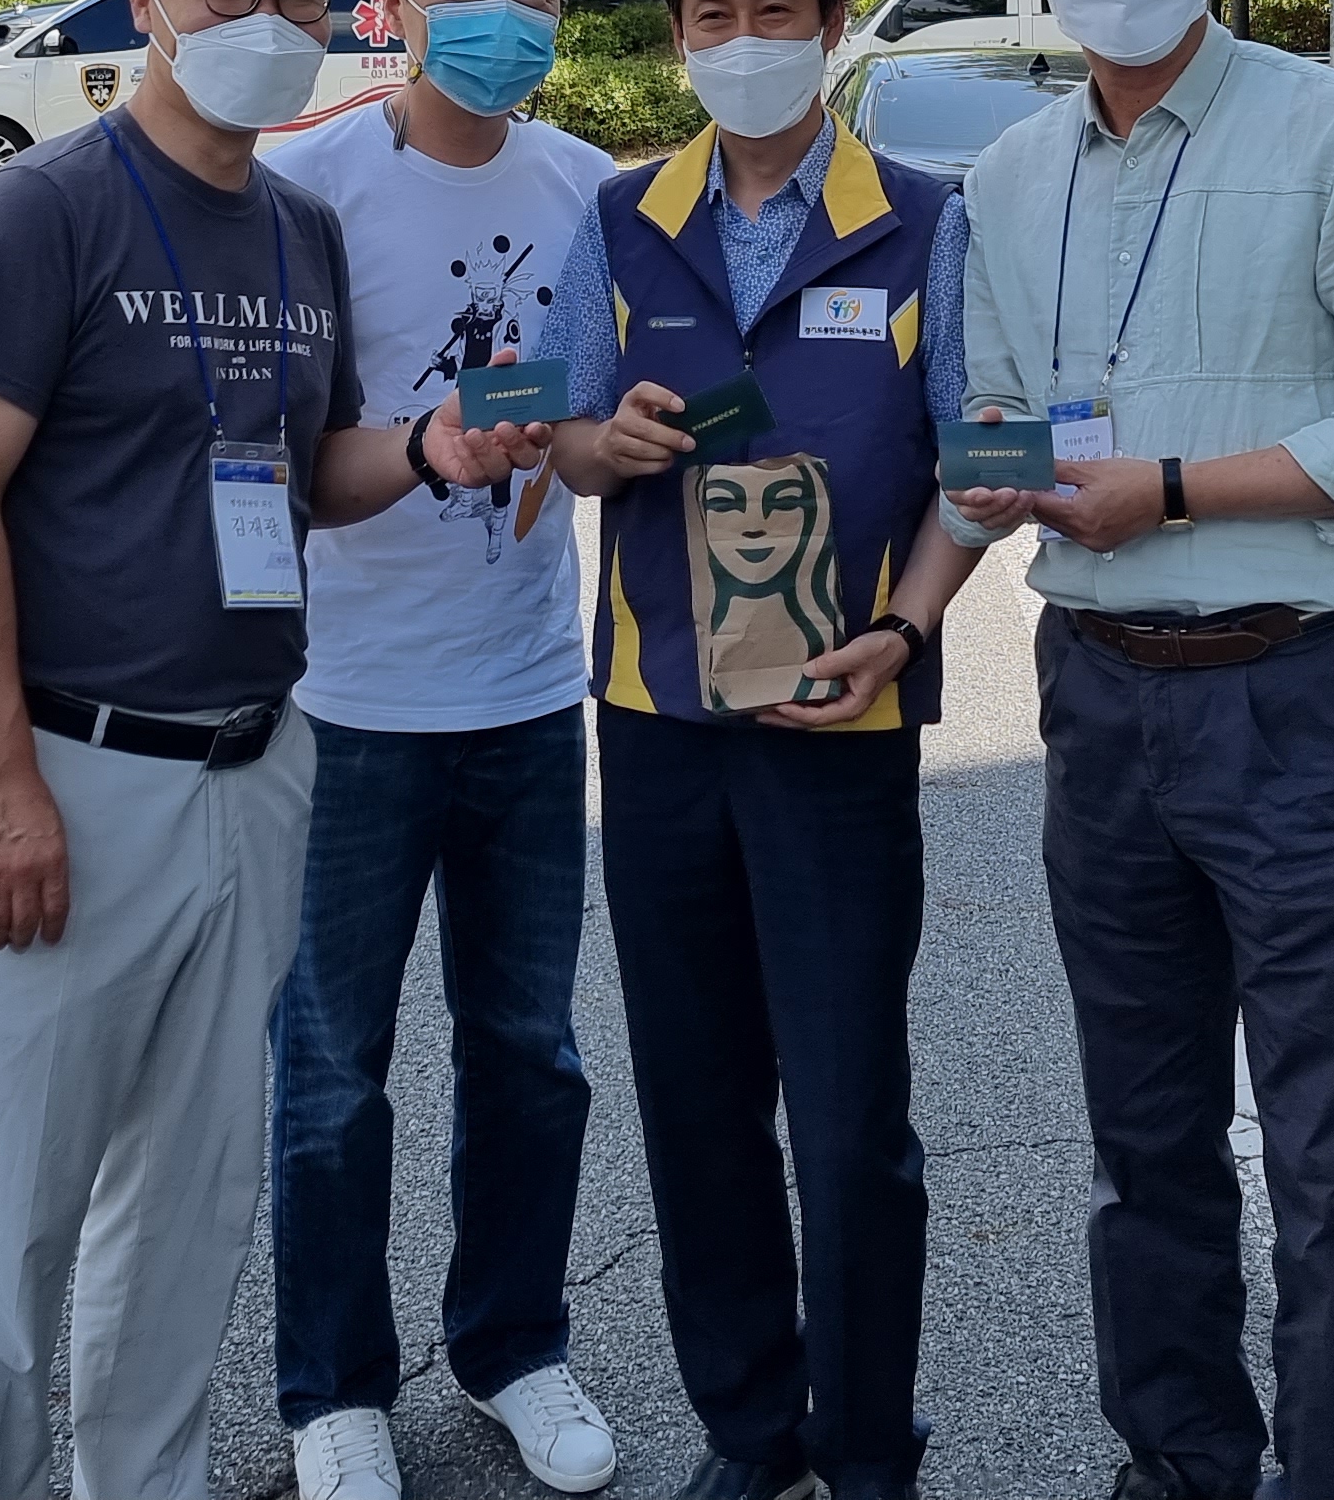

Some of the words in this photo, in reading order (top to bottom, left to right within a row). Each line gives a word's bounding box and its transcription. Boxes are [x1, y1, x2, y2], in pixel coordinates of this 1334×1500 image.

[113, 290, 336, 342] WELLMADE
[170, 335, 191, 348] FOR
[194, 336, 212, 349] UR
[213, 337, 235, 351] WORK
[238, 339, 245, 351] &
[249, 339, 272, 352] LIFE
[216, 367, 272, 380] INDIAN
[485, 387, 540, 401] STARBUCKS
[691, 406, 740, 432] STARBUCKS
[967, 449, 1024, 458] STARBUCKS
